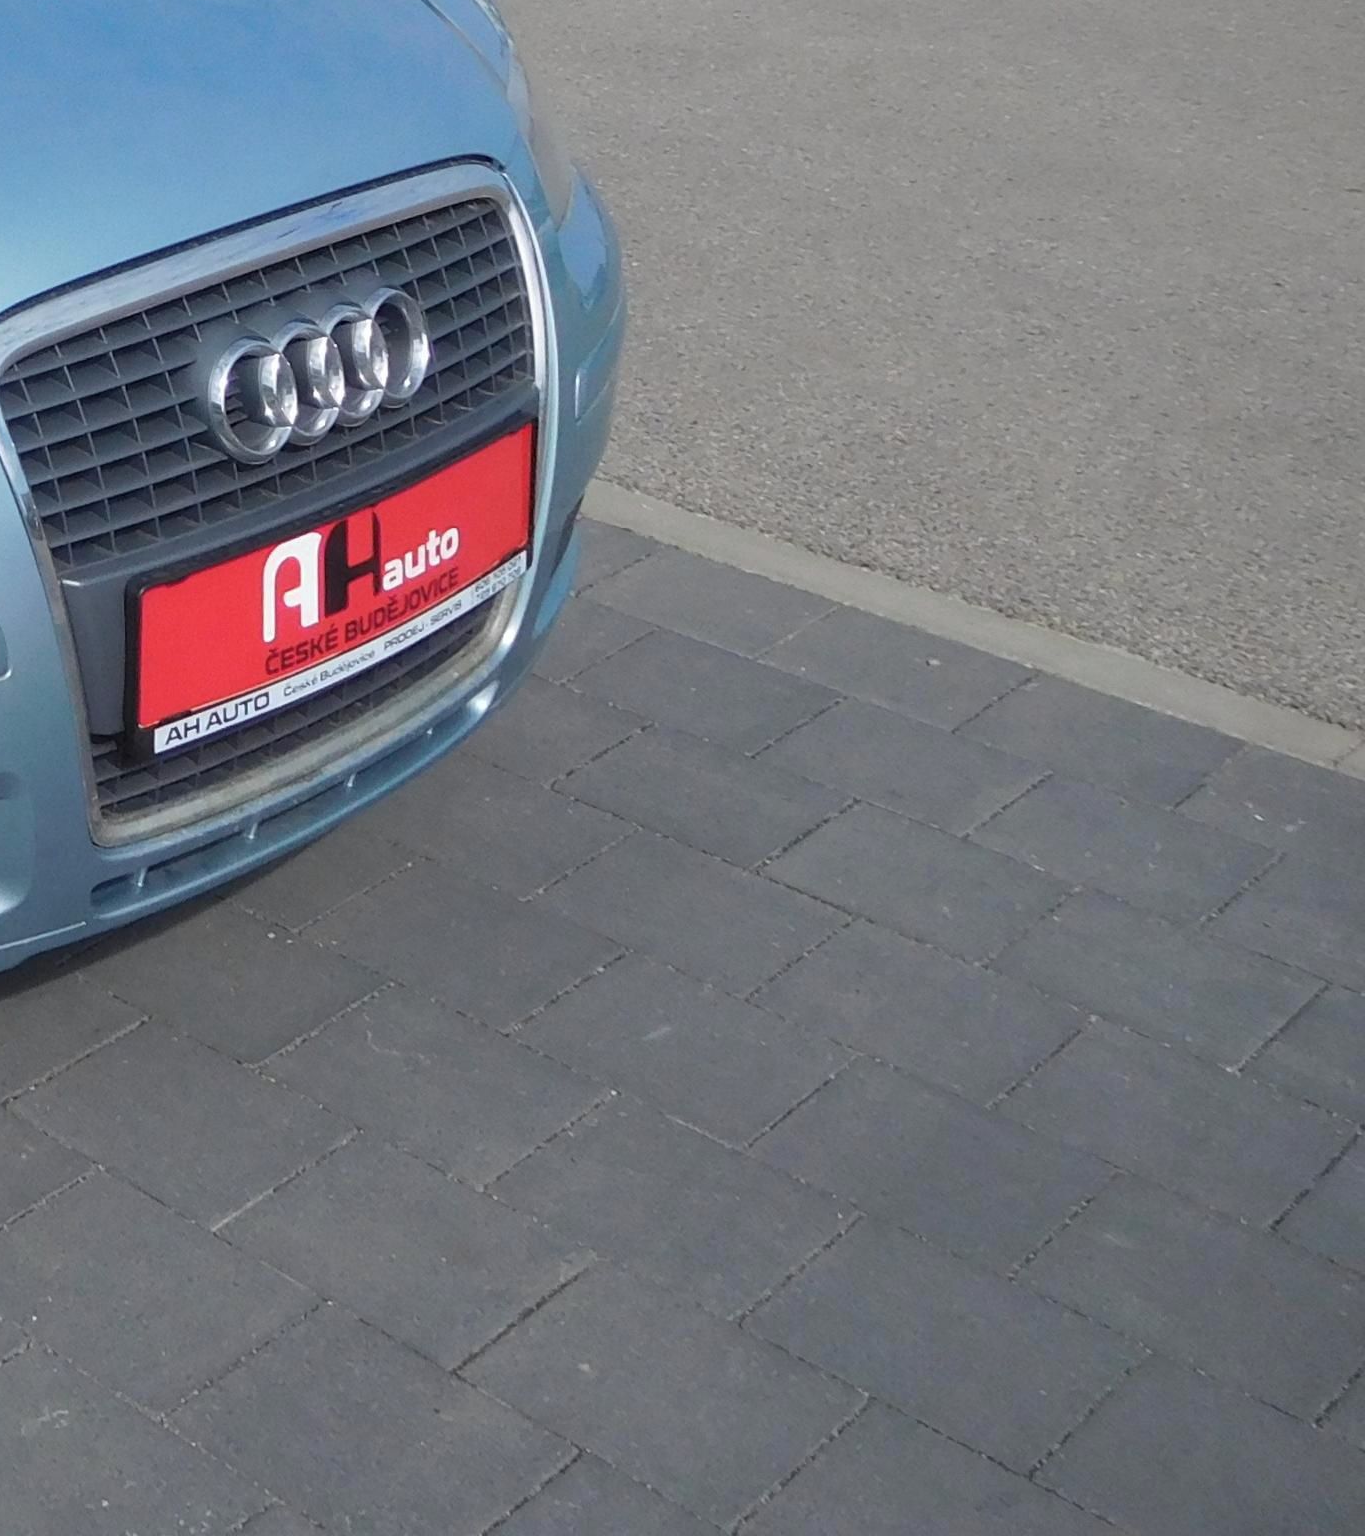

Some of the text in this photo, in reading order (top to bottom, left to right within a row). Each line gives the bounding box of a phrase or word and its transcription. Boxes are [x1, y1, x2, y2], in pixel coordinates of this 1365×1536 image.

[165, 717, 200, 745] AH
[206, 691, 270, 731] AUTO
[383, 624, 425, 650] PRODEJ
[430, 599, 462, 625] SERVIS
[265, 622, 339, 676] ČESKÉ
[343, 567, 459, 644] BUDĚJOVICE
